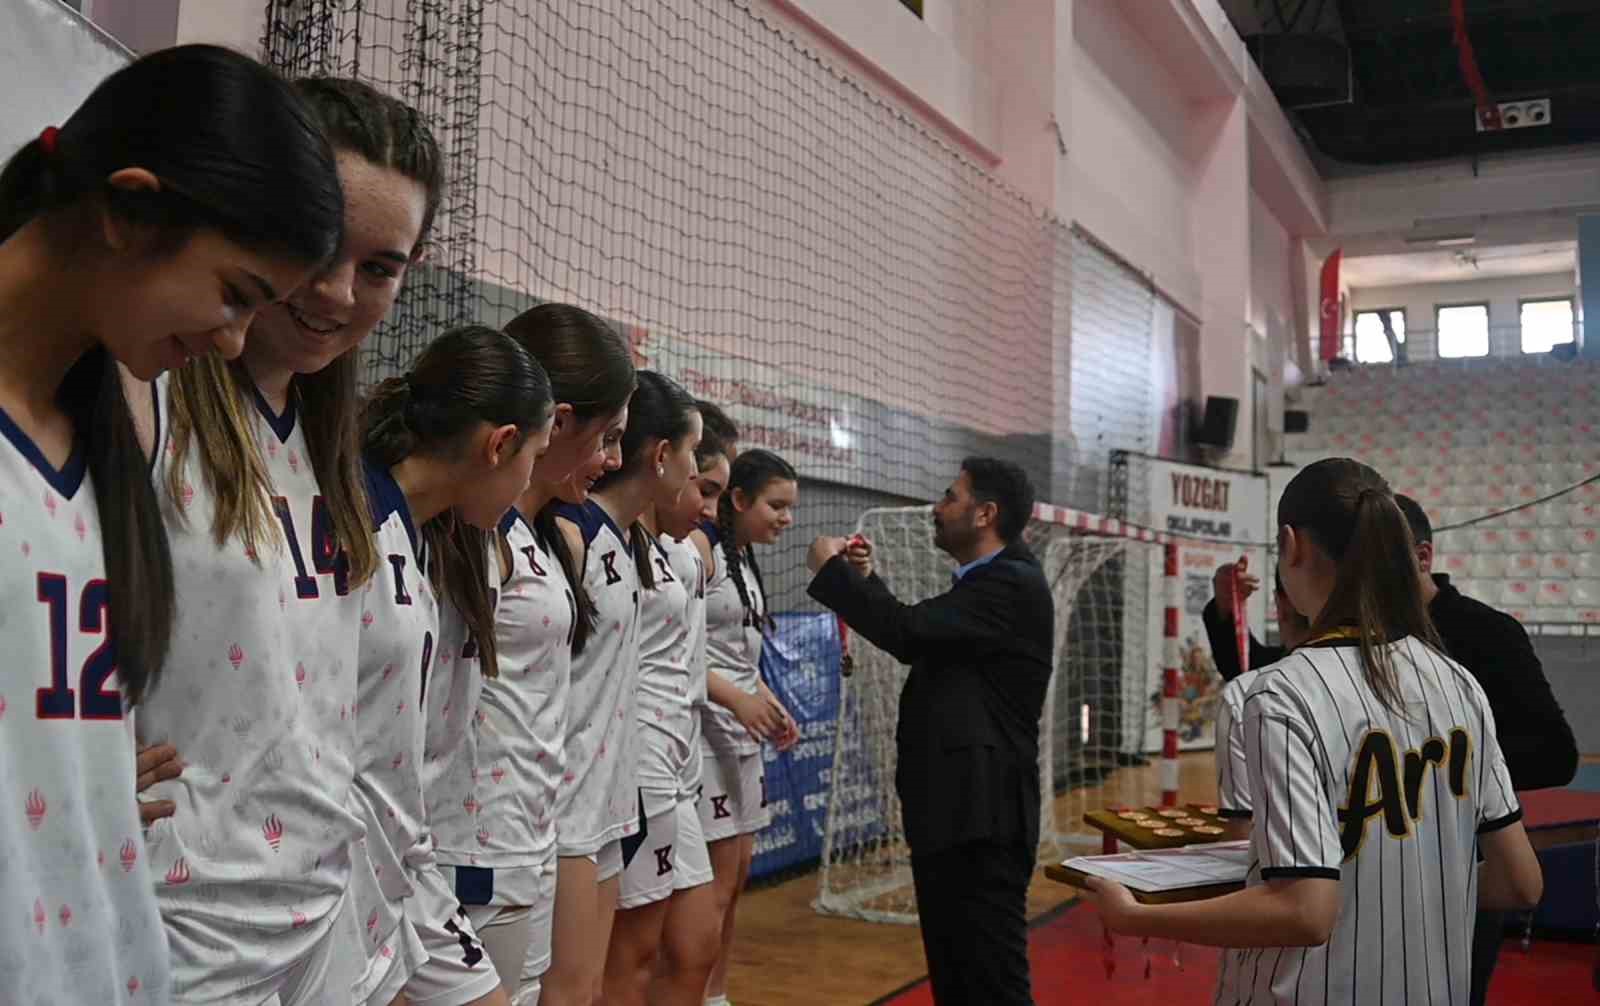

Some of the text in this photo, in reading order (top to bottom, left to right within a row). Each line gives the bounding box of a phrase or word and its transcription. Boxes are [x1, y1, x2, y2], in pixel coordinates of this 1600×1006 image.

[1171, 472, 1229, 512] YOZGAT
[601, 550, 621, 586] K
[36, 571, 124, 720] 12
[710, 794, 731, 820] K
[654, 844, 673, 877] K
